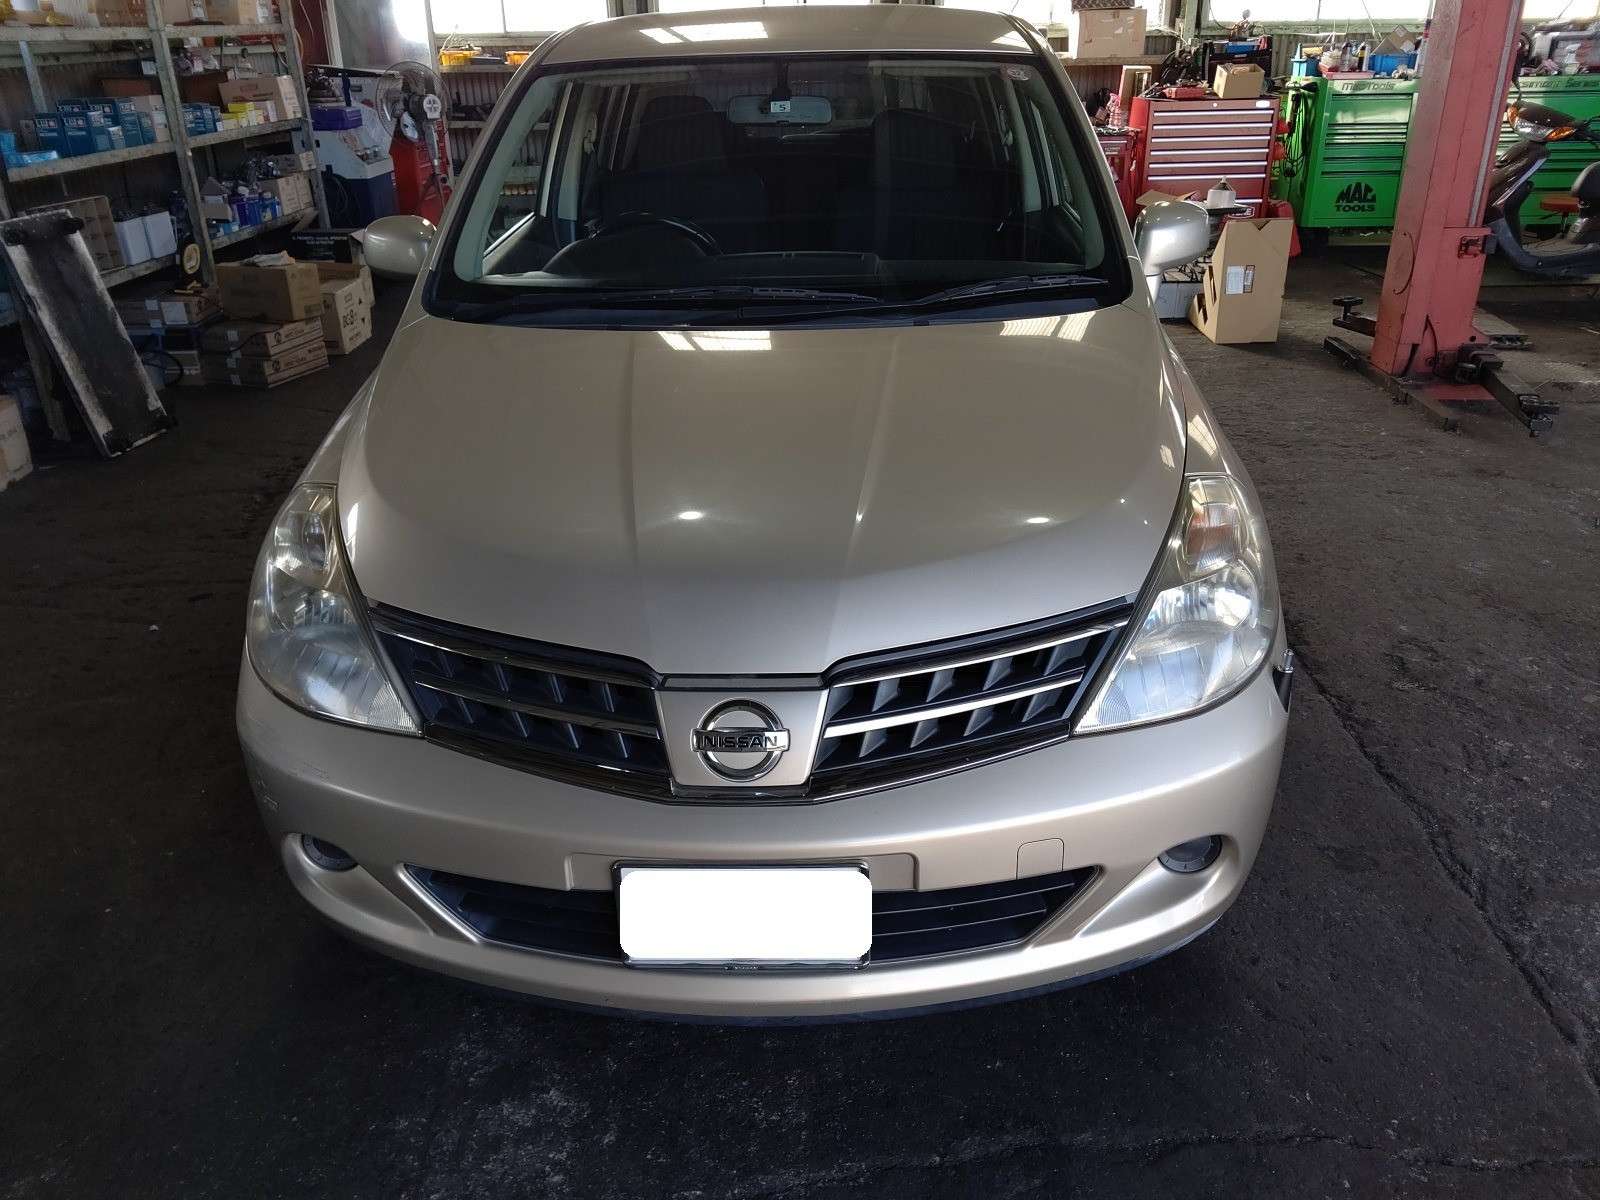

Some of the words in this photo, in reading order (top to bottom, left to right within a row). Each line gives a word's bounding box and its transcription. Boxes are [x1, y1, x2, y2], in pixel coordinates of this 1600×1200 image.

[1335, 181, 1377, 203] MAC
[1335, 204, 1376, 212] TOOLS
[701, 735, 778, 748] NISSAN
